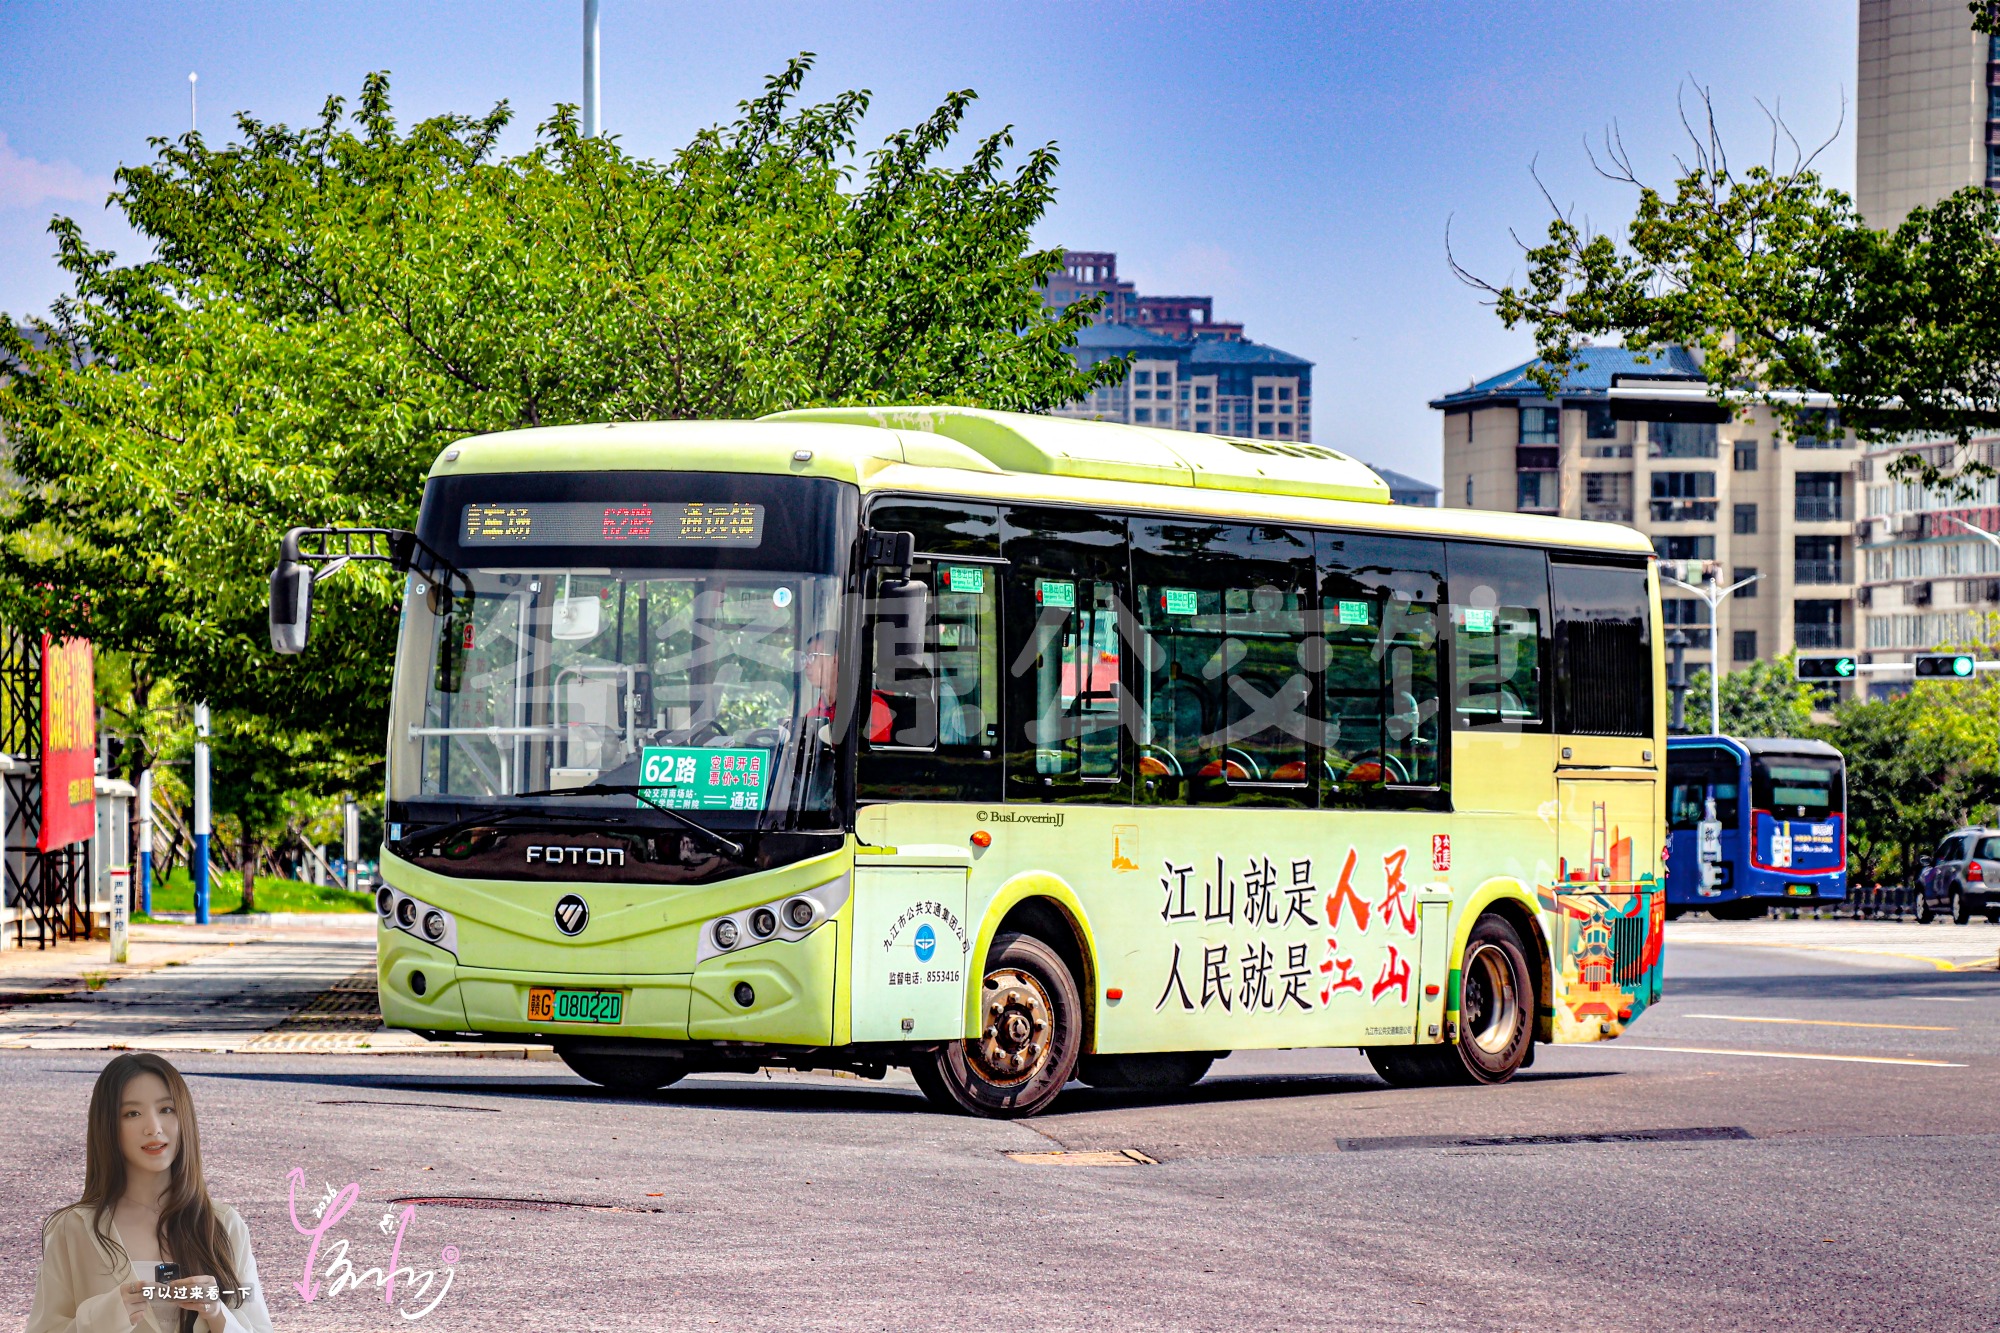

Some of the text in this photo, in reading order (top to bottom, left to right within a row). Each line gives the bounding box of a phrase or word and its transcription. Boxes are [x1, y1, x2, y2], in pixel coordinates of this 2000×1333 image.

[645, 755, 697, 784] 62路
[711, 756, 760, 771] 空调开启
[730, 791, 759, 810] 通远
[526, 841, 625, 866] FOTON
[1160, 847, 1417, 935] 江山就是人民
[883, 900, 971, 954] 九江市公共交通集团公司
[927, 970, 960, 982] 8553416
[1155, 938, 1411, 1012] 人民就是江山
